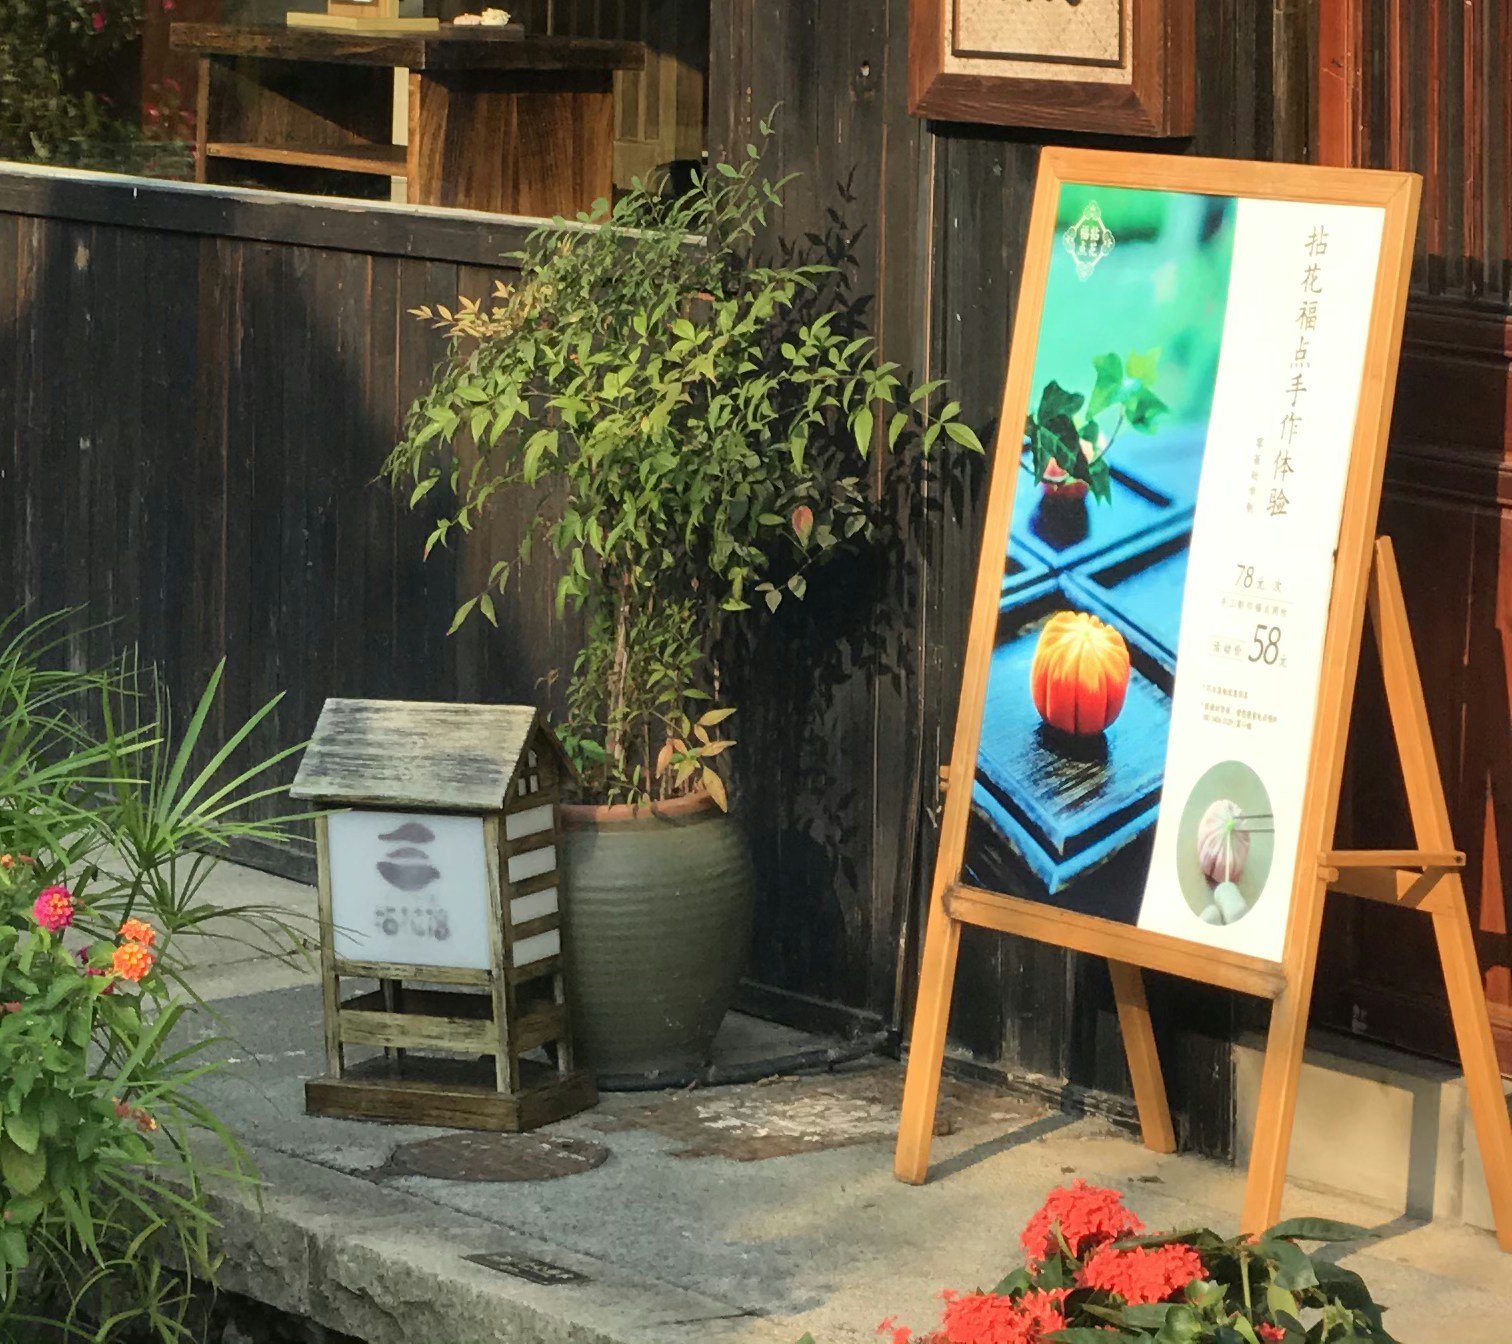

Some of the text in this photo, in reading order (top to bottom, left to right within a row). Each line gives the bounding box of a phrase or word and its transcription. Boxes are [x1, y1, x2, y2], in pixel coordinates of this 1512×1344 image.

[1266, 224, 1330, 517] 拈花福点手作体验
